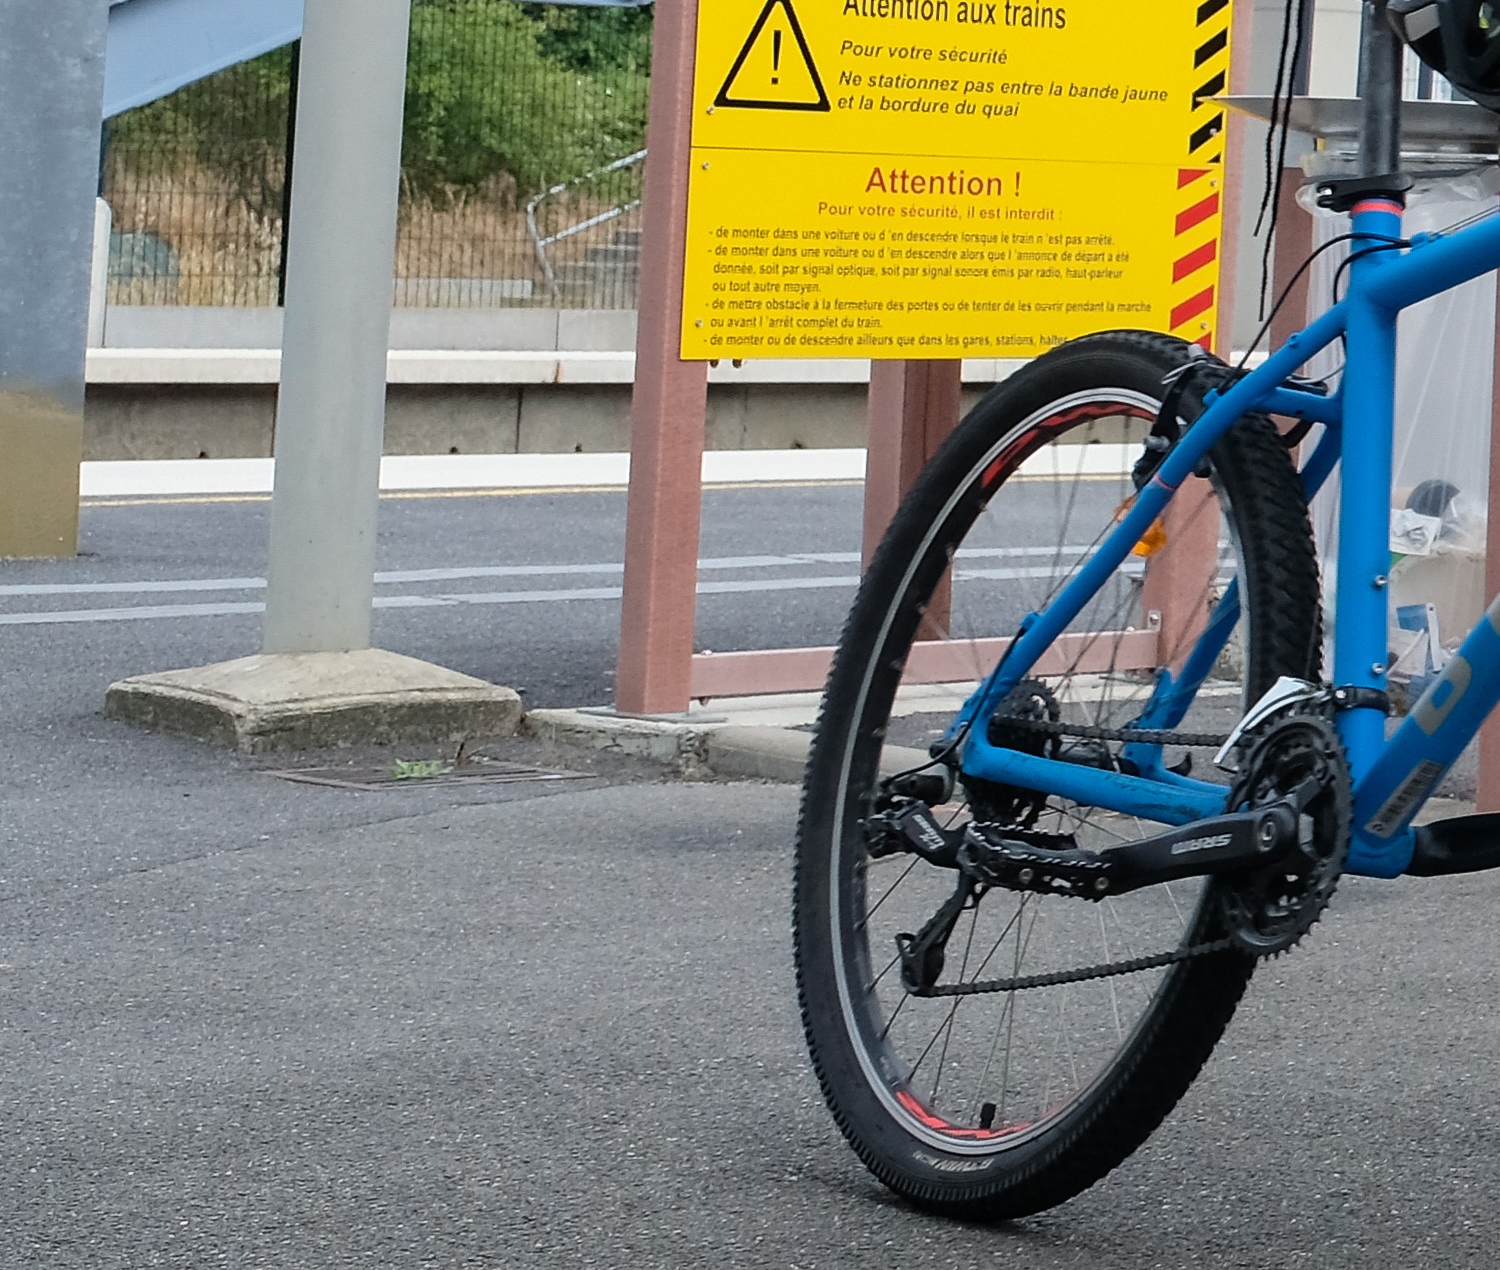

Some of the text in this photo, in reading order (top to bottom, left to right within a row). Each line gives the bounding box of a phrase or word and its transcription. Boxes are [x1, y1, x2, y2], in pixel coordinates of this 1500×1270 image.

[956, 1, 996, 24] aux
[839, 39, 1007, 64] Pour votre sécurité
[838, 70, 1168, 103] Ne stationnez pas entre la bande jaune
[836, 94, 1019, 119] et la bordure du quai
[864, 167, 1002, 196] Attention
[817, 200, 1054, 220] Pour votre sécurité, il est interdit
[758, 262, 779, 275] soit
[781, 264, 800, 277] par
[801, 262, 834, 278] signal
[880, 265, 900, 276] soit
[902, 266, 920, 278] par
[921, 264, 954, 280] signal
[991, 265, 1015, 277] émis
[1016, 268, 1034, 280] par
[711, 281, 726, 292] ou
[728, 280, 751, 292] tout
[752, 281, 781, 292] autre
[709, 317, 724, 328] ou
[726, 316, 757, 328] avant
[840, 316, 854, 328] du
